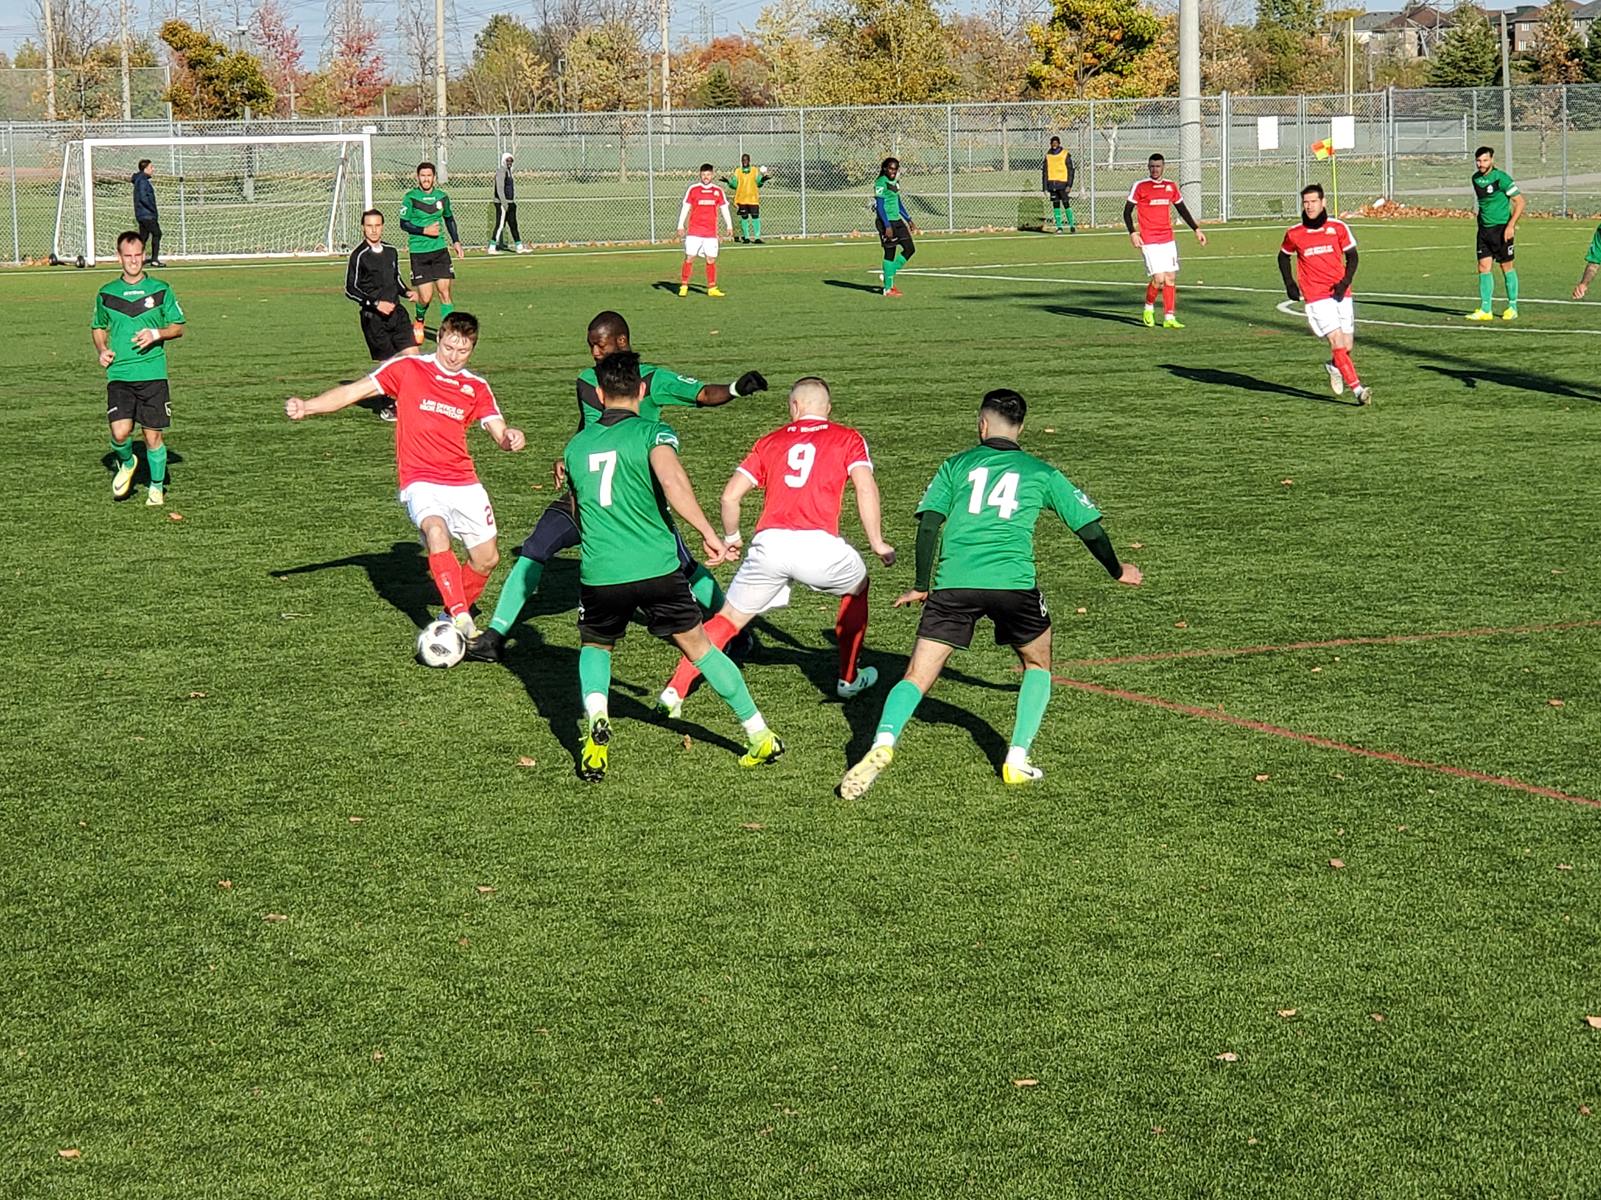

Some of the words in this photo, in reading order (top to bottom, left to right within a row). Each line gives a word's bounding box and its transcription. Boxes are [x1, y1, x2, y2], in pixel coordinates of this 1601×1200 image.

[588, 450, 617, 507] 7
[784, 442, 816, 488] 9
[967, 466, 1020, 519] 14
